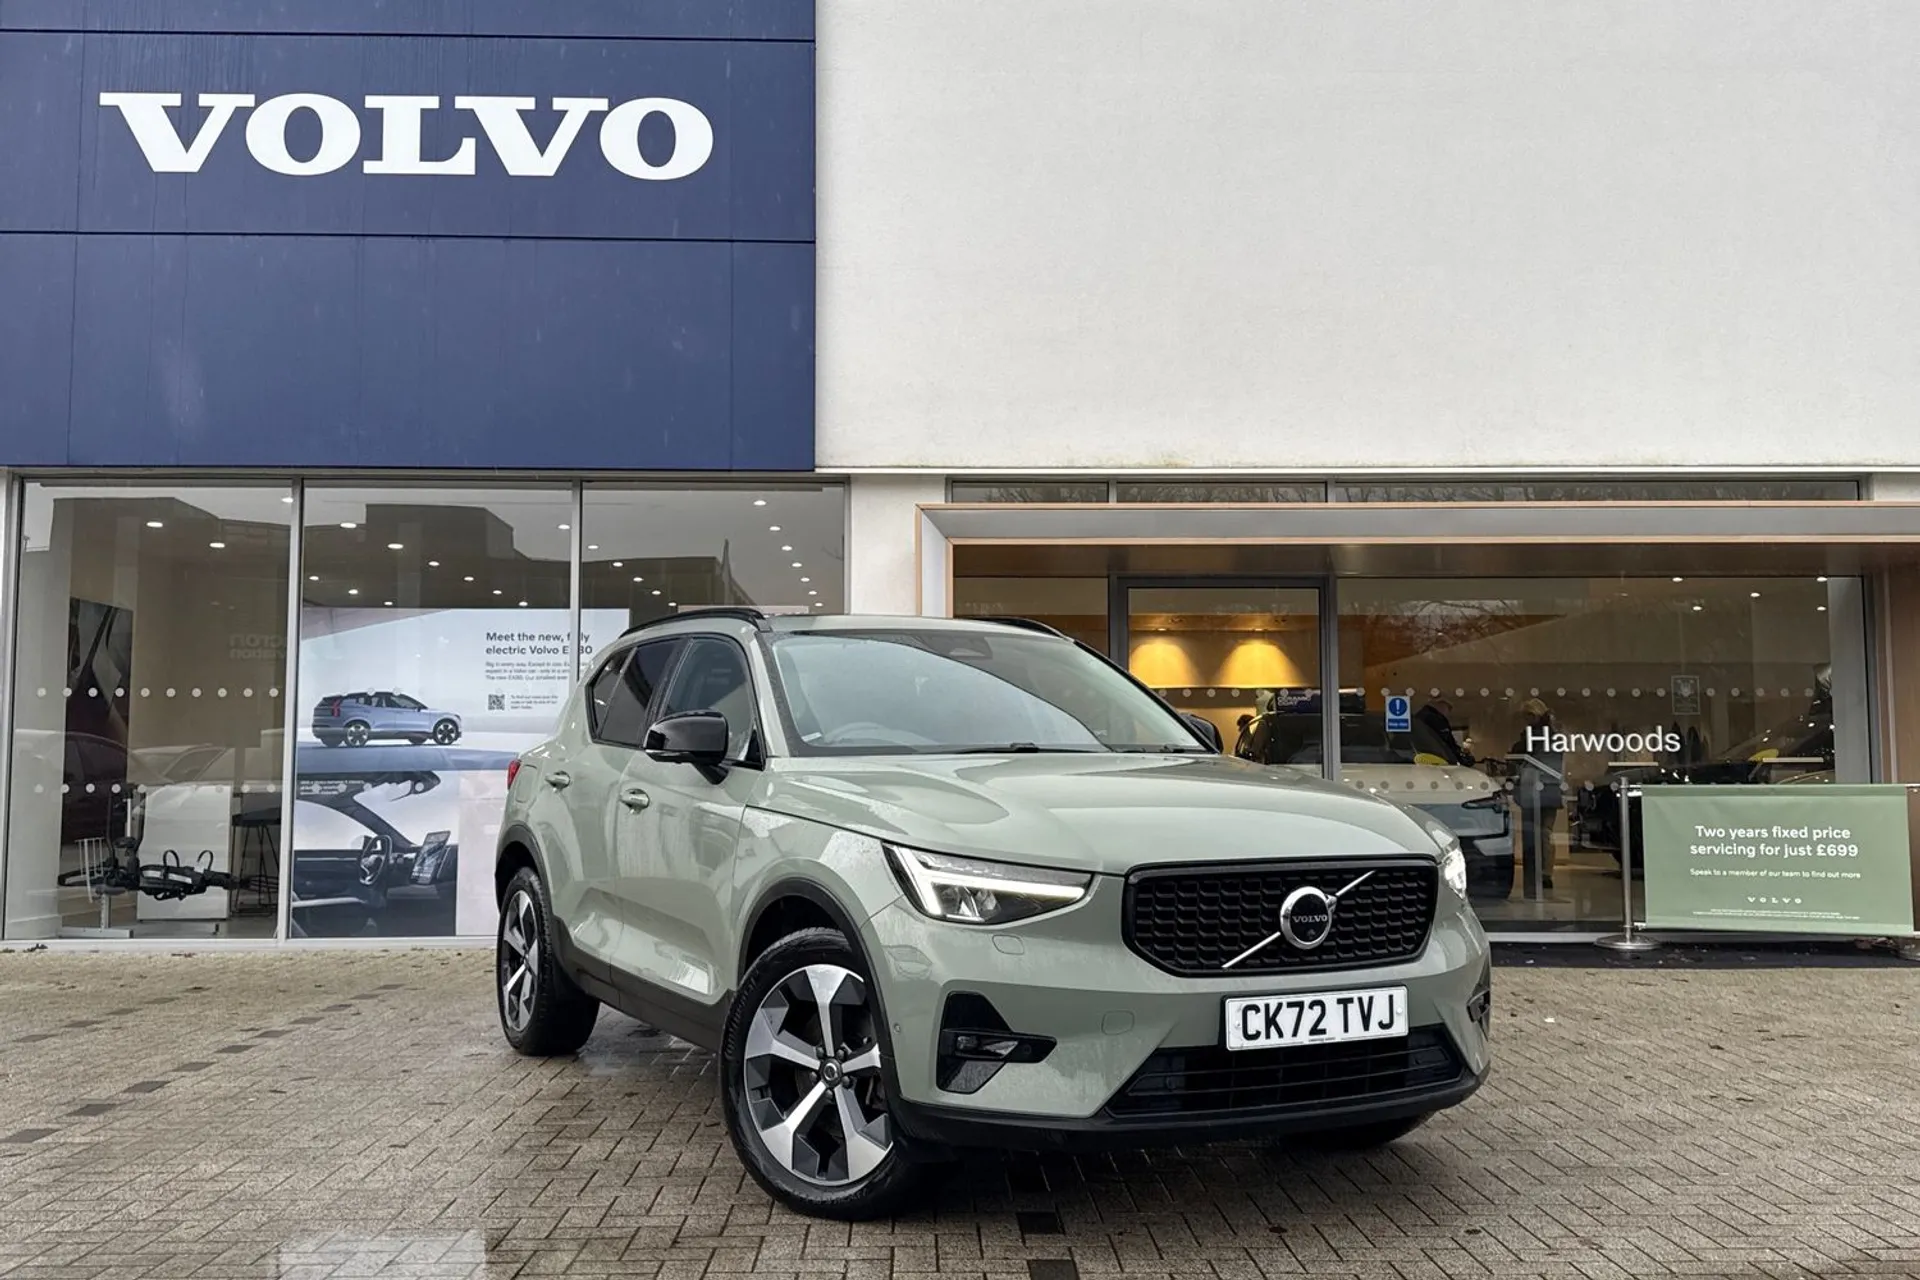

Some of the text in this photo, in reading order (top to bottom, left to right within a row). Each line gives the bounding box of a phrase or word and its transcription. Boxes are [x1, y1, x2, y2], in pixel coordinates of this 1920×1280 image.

[99, 92, 714, 181] VOLVO
[486, 632, 590, 643] Meet the new, fly
[485, 645, 593, 655] electric Volvo E30
[1526, 725, 1681, 753] Harwoods
[1695, 825, 1851, 841] Two years fixed price
[1690, 843, 1858, 858] servicing for just £699
[1690, 868, 1712, 876] Speak
[1728, 869, 1758, 877] member
[1759, 869, 1767, 877] of
[1802, 870, 1810, 878] to
[1811, 870, 1826, 878] find
[1747, 896, 1802, 904] VOLVO
[1292, 914, 1328, 923] VOLVO
[1241, 994, 1394, 1041] CK72 TVJ
